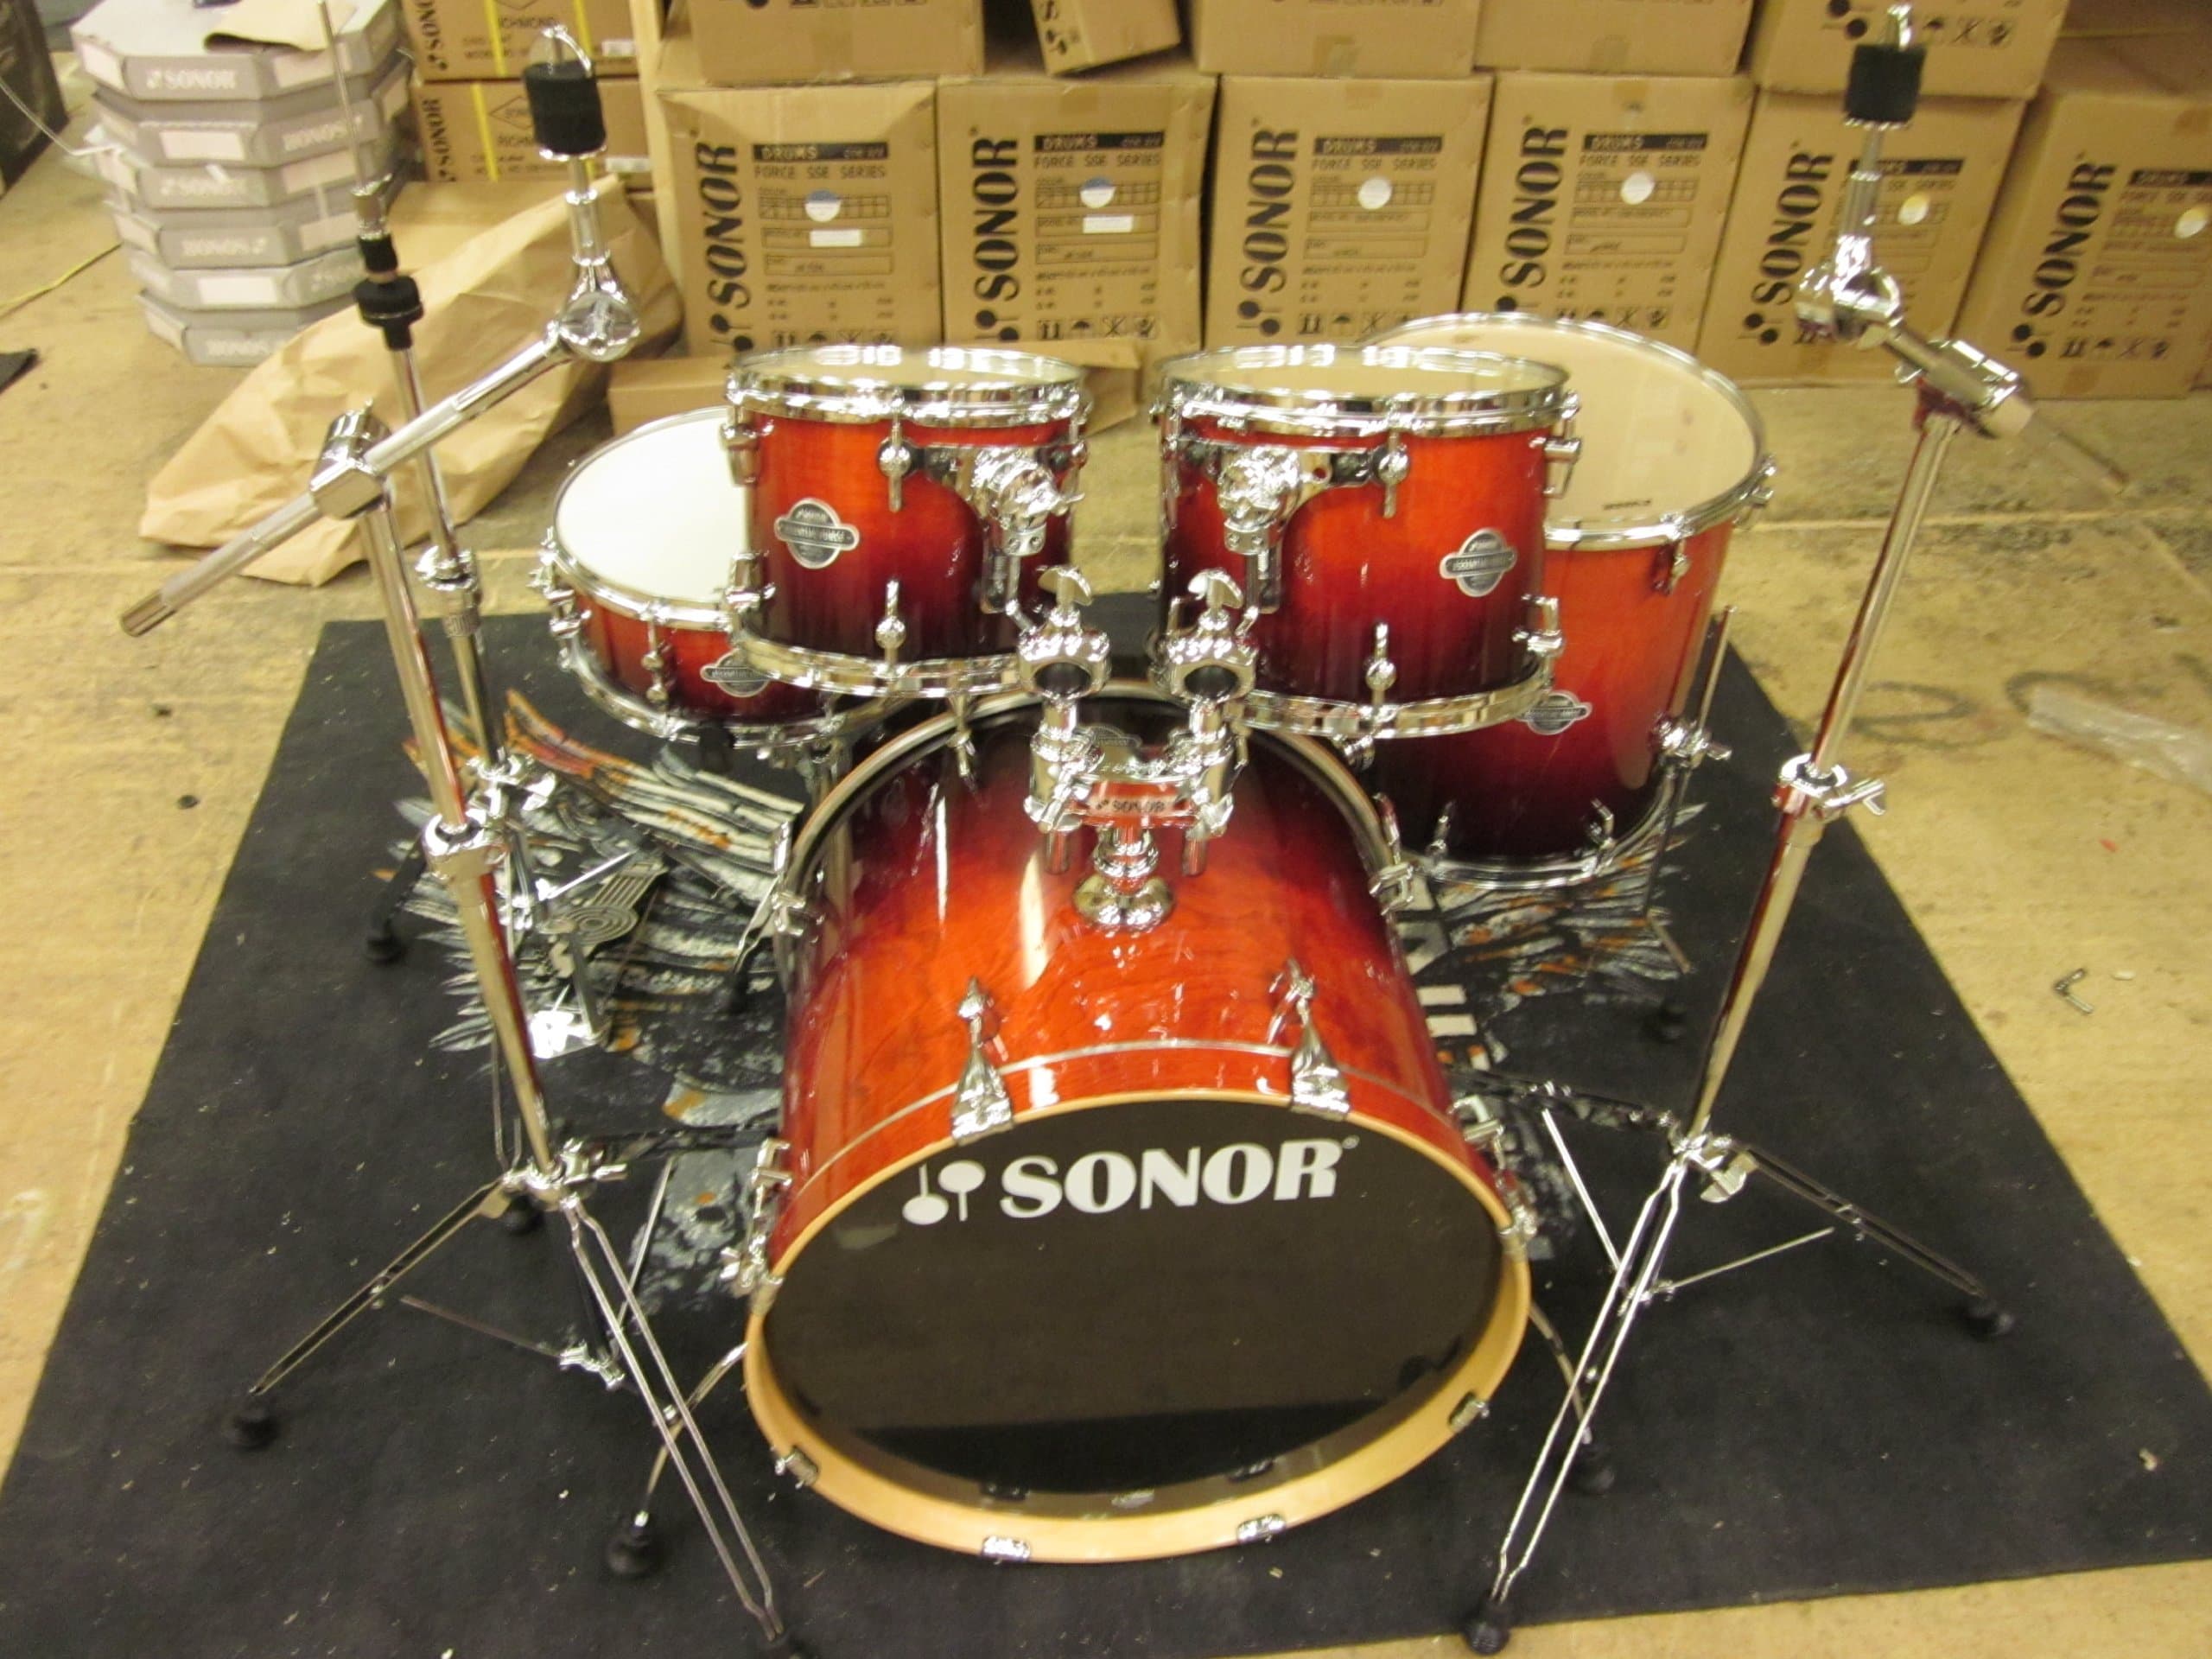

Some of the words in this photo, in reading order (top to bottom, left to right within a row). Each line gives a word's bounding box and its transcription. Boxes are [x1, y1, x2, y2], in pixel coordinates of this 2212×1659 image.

[754, 165, 795, 178] FORCE
[840, 164, 886, 178] SERIES
[761, 145, 817, 160] DRUMS
[1043, 135, 1097, 149] DRUMS
[1239, 130, 1299, 294] SONOR
[1500, 127, 1569, 289] SONOR
[694, 141, 752, 309] SONOR
[972, 138, 1020, 302] SONOR
[1751, 152, 1835, 306] SONOR
[2022, 162, 2116, 317] SONOR
[1000, 1138, 1344, 1218] SONOR
